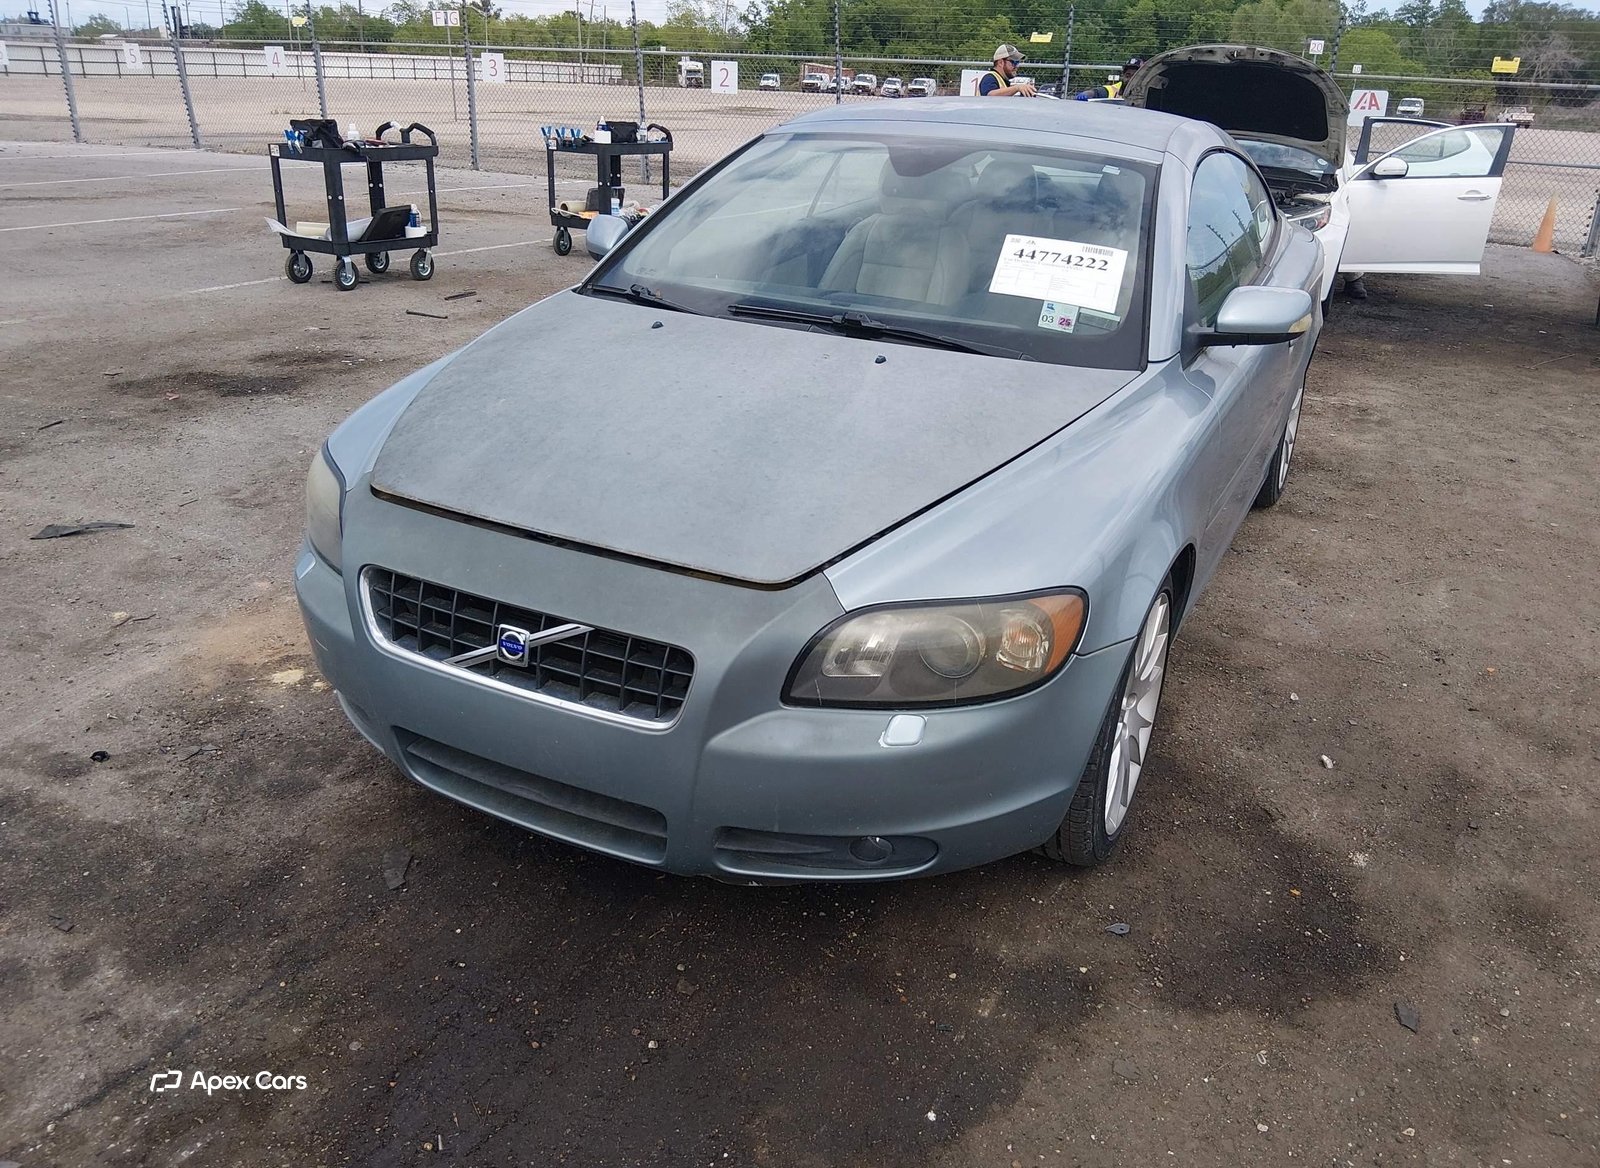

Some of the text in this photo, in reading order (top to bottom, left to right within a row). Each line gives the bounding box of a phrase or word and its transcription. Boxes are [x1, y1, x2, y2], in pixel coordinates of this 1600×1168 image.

[434, 11, 459, 26] F G
[1310, 42, 1323, 52] 20
[129, 48, 137, 64] 5
[272, 51, 281, 68] 4
[488, 58, 498, 77] 3
[719, 67, 730, 88] 2
[970, 77, 979, 97] 1
[1013, 248, 1109, 272] 44774222
[1041, 314, 1055, 324] 03
[502, 640, 523, 651] VOLVO
